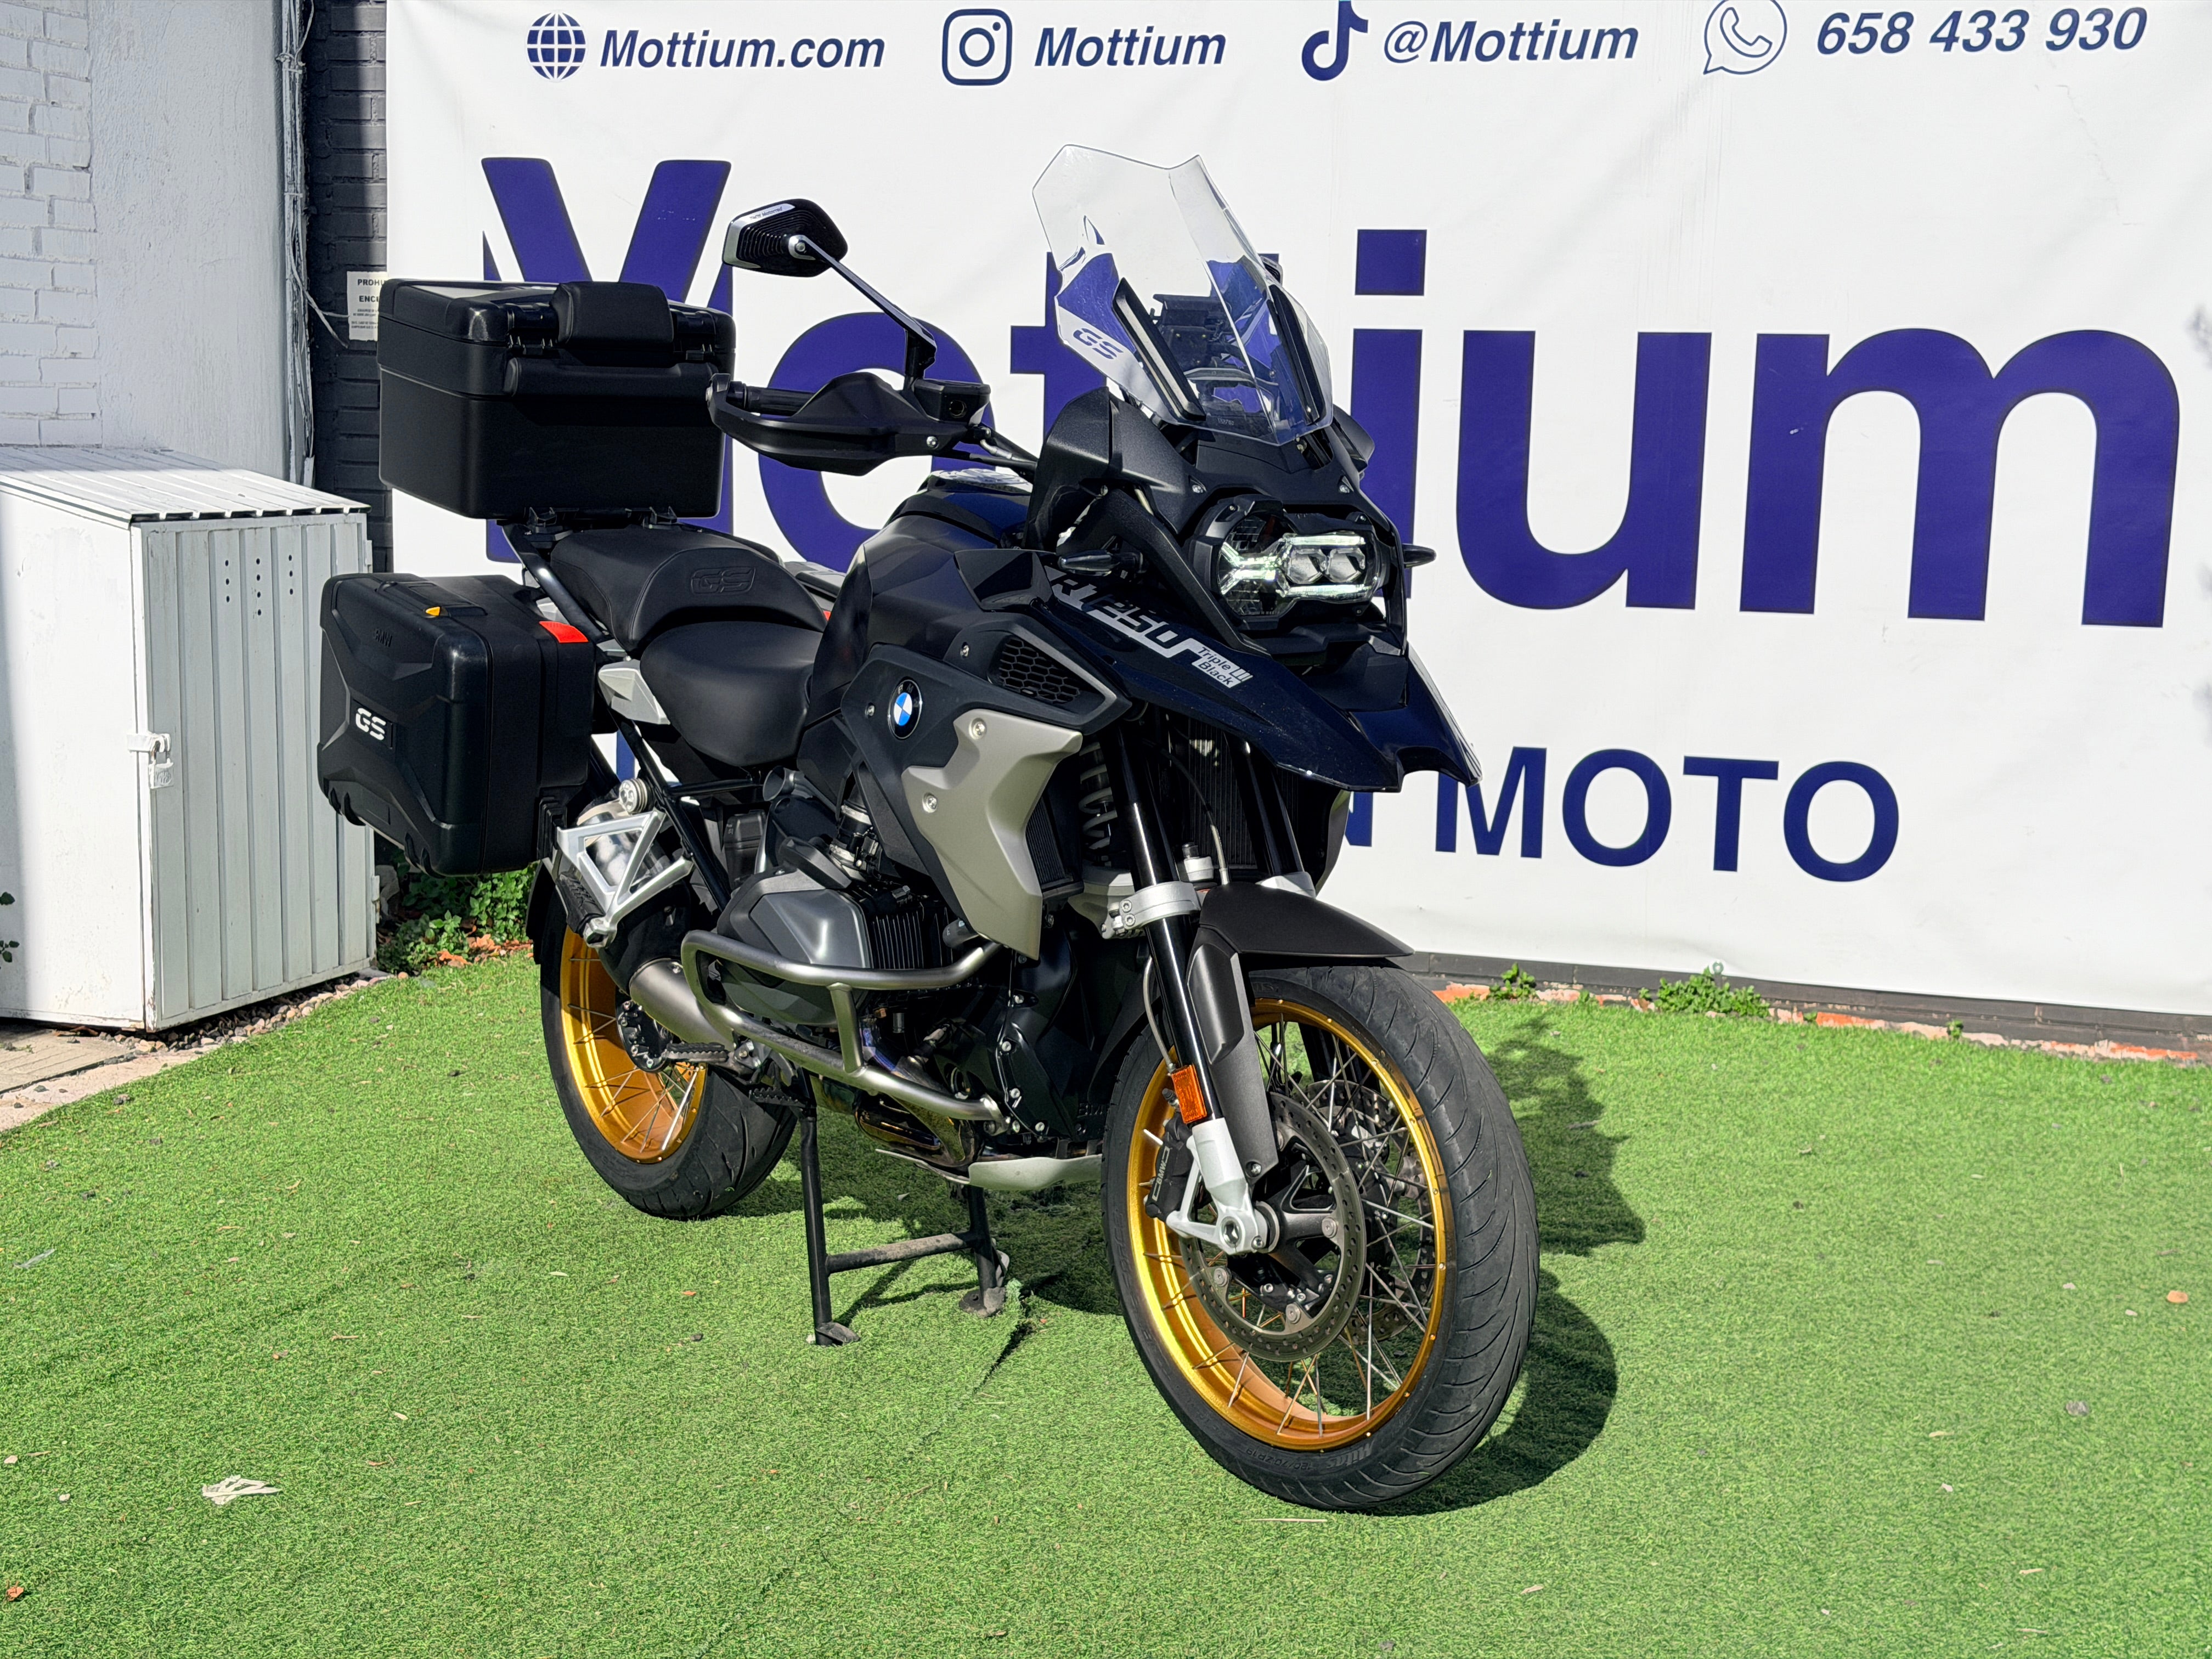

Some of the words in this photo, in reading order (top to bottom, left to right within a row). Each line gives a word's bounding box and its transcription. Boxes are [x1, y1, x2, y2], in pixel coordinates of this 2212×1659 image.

[1035, 26, 1226, 66] Mottium
[1384, 19, 1638, 63] @Mottium
[1818, 12, 1914, 54] 658
[1929, 9, 2029, 52] 433
[2046, 8, 2147, 51] 930
[601, 30, 884, 67] Mottium.com
[1073, 328, 1124, 359] GS
[691, 566, 755, 595] GS
[1198, 647, 1231, 670] Triple
[1198, 662, 1234, 685] Black
[356, 707, 387, 741] GS
[1435, 747, 1899, 882] MOTO
[1156, 1159, 1167, 1185] BMW
